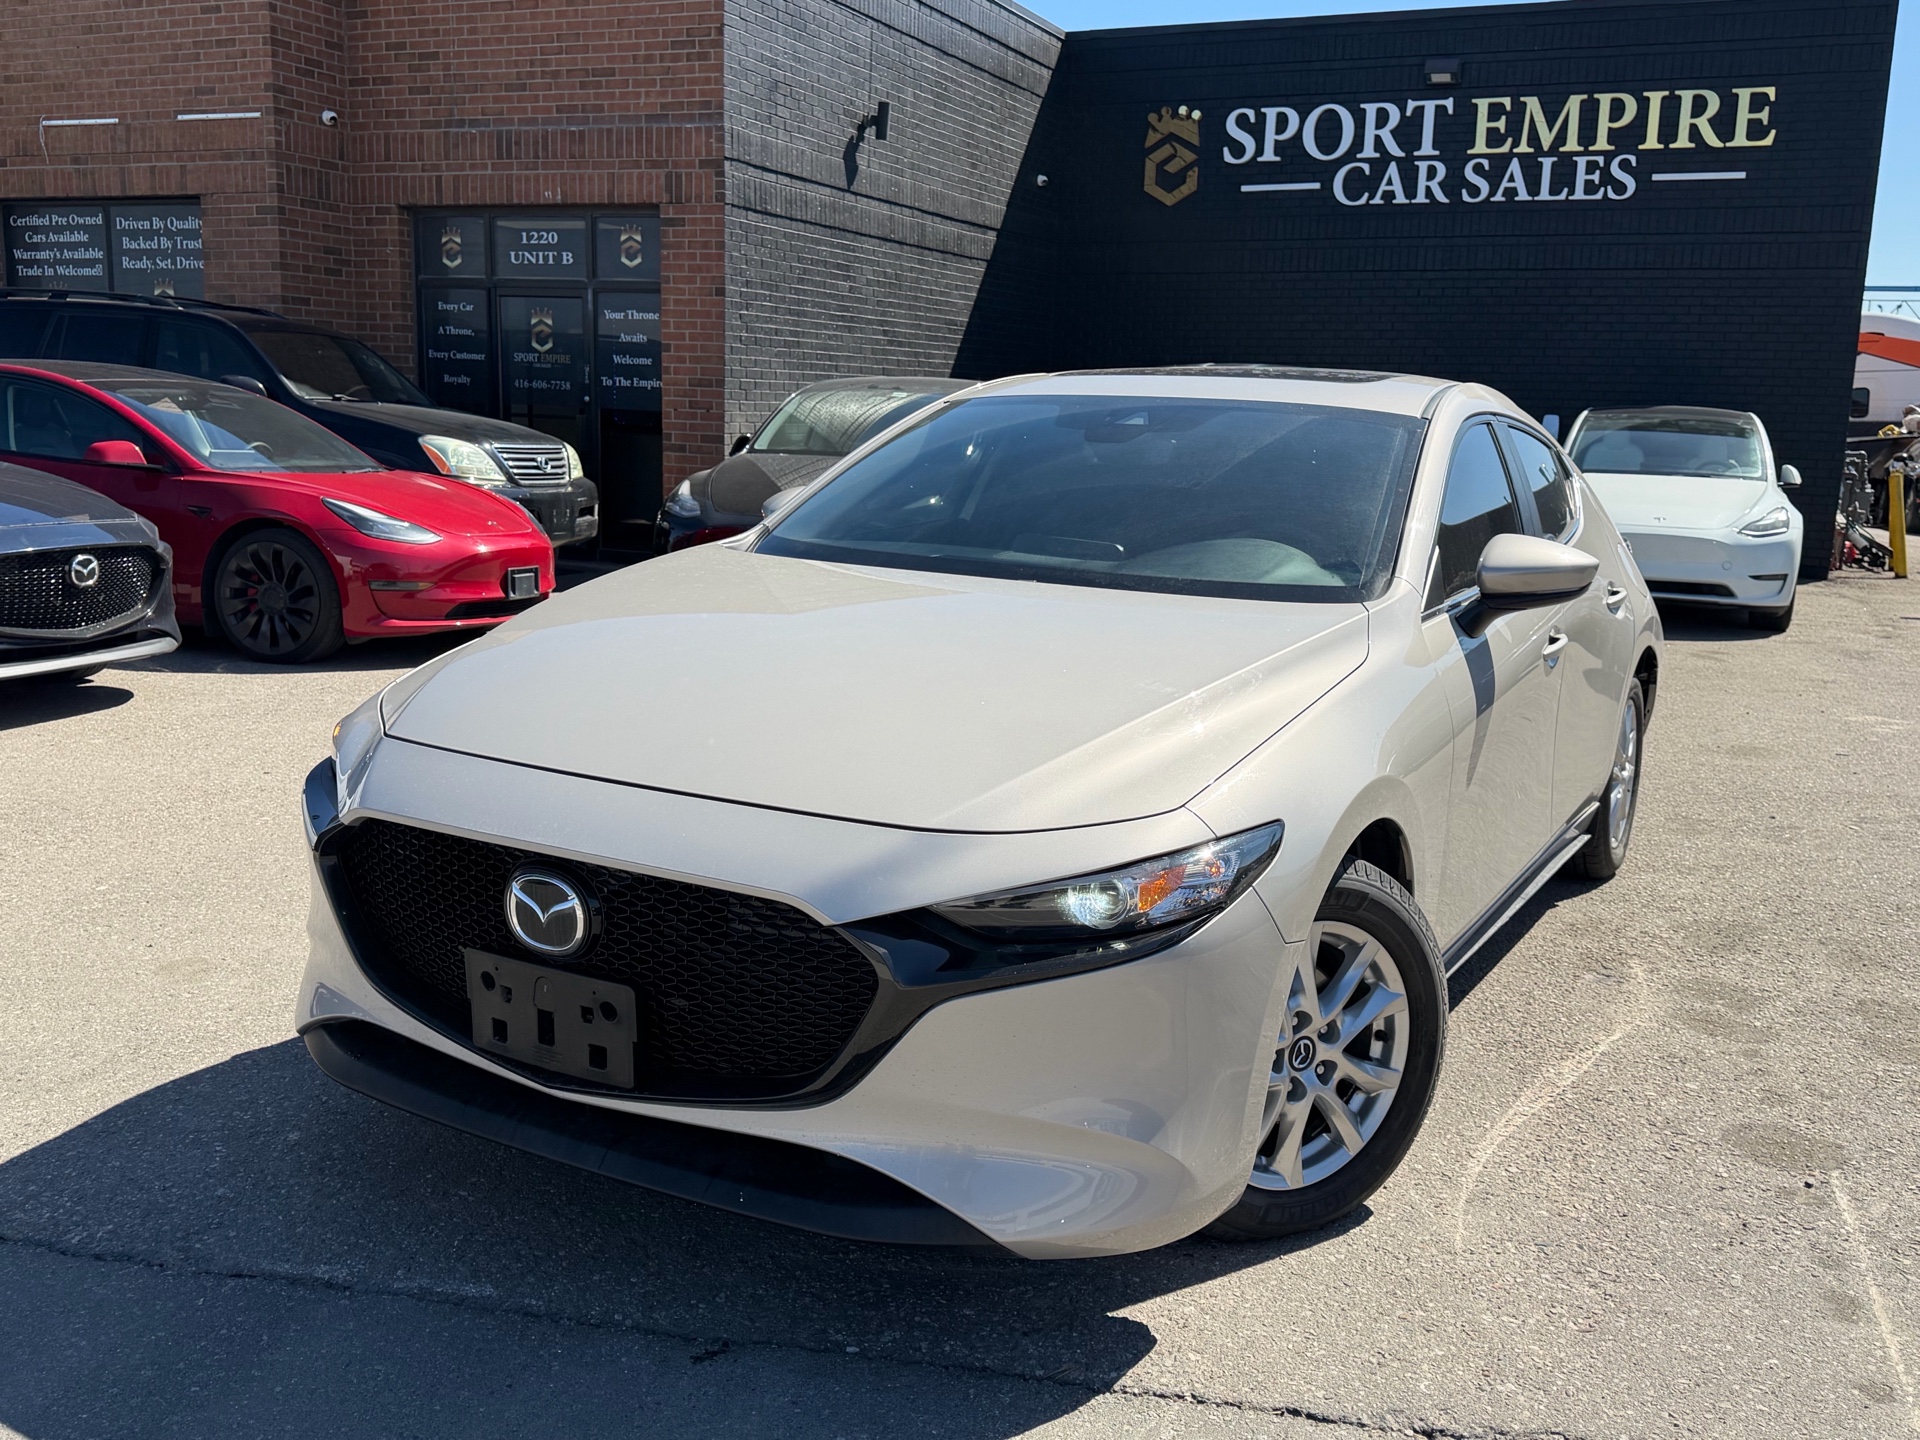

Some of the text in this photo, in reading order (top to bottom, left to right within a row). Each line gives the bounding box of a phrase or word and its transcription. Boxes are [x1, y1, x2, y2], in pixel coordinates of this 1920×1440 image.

[1223, 86, 1776, 164] SPORT EMPIRE
[1333, 154, 1637, 205] CAR SALES
[10, 213, 103, 226] Certified Pre Owned
[116, 217, 151, 230] Driven
[152, 217, 166, 233] By
[25, 230, 89, 243] Cars Available
[521, 231, 559, 244] 1220
[122, 236, 203, 253] Backed By Trust
[62, 247, 104, 259] Available
[509, 251, 574, 265] UNIT B
[16, 265, 43, 276] Trade
[44, 265, 55, 276] In
[122, 256, 204, 273] Ready, Set, Drive
[438, 301, 475, 313] Every Car
[604, 309, 660, 320] Your Throne
[438, 326, 475, 336] A Throne,
[619, 333, 648, 343] Awaits
[428, 350, 486, 361] Every Customer
[513, 353, 571, 364] SPORT EMPIRE
[613, 354, 653, 365] Welcome
[444, 374, 471, 386] Royalty
[514, 379, 571, 391] 416-606-7758
[601, 376, 613, 387] To
[613, 376, 632, 387] The
